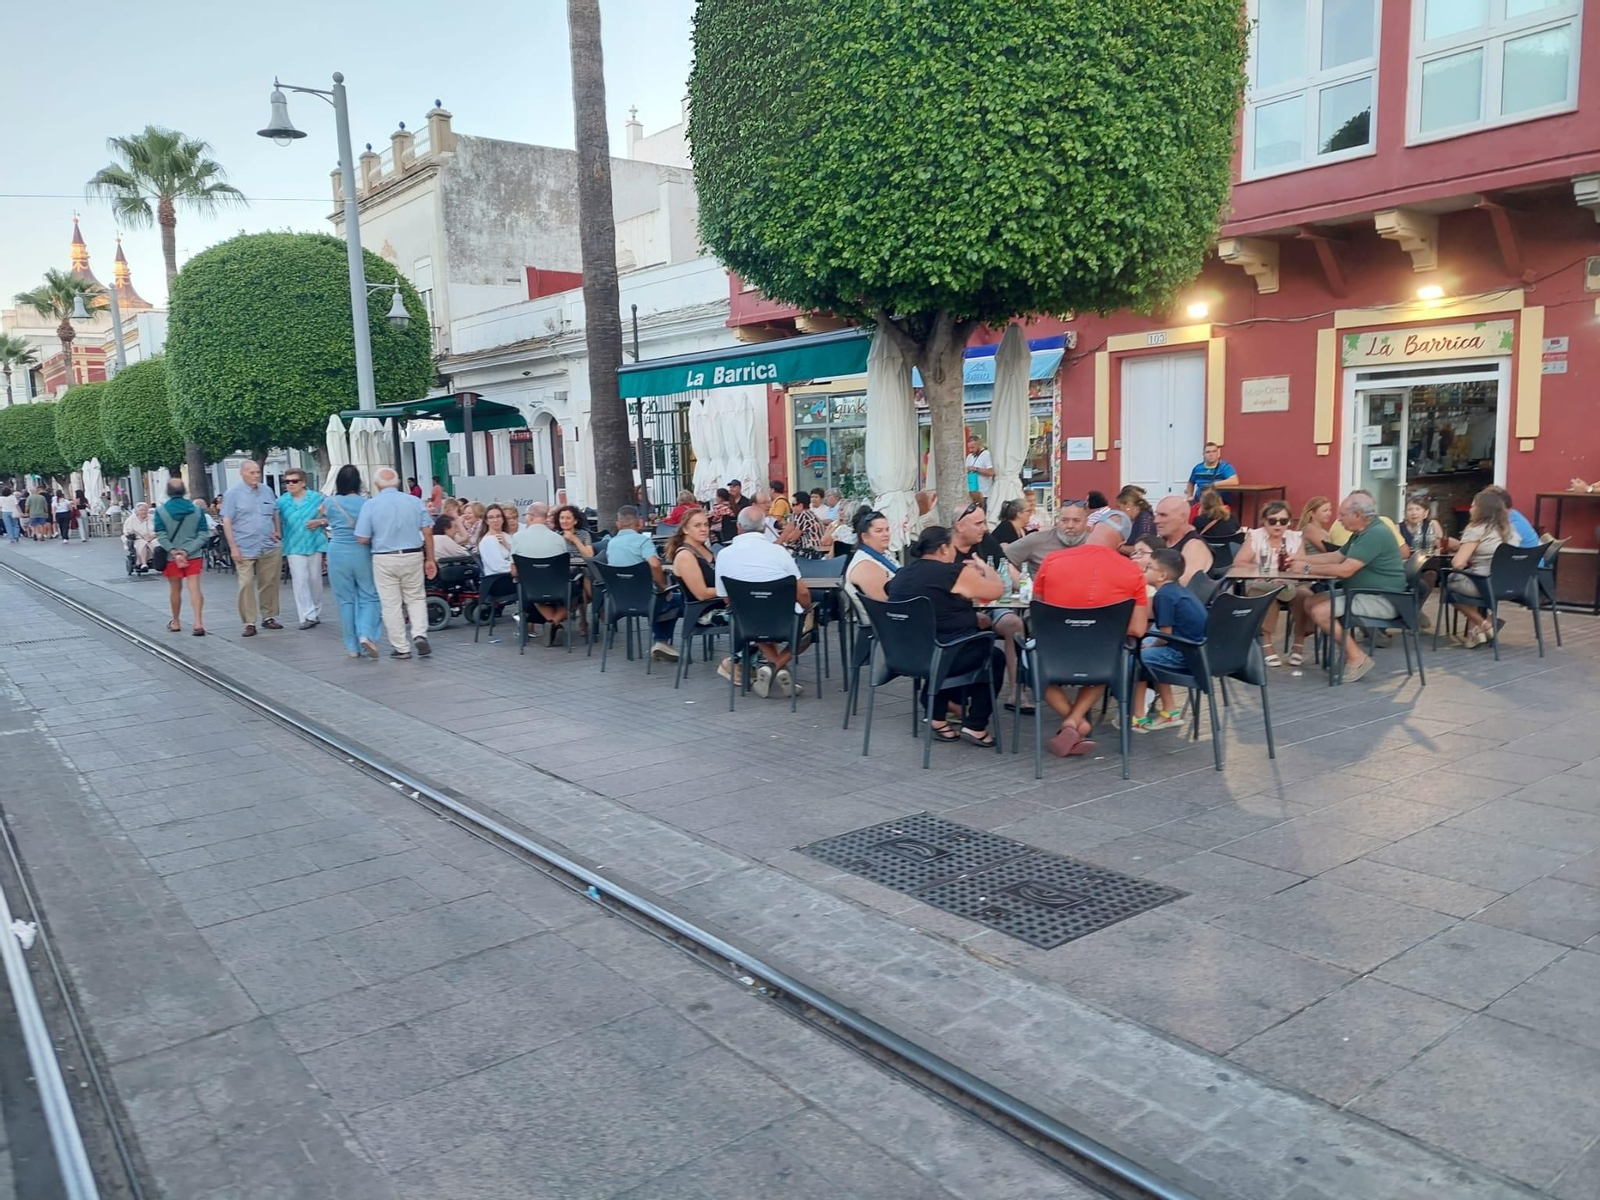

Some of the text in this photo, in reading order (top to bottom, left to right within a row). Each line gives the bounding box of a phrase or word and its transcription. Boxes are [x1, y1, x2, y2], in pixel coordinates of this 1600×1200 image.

[1149, 333, 1165, 344] 103
[1365, 334, 1485, 357] La Barrica
[686, 361, 777, 387] La Barrica
